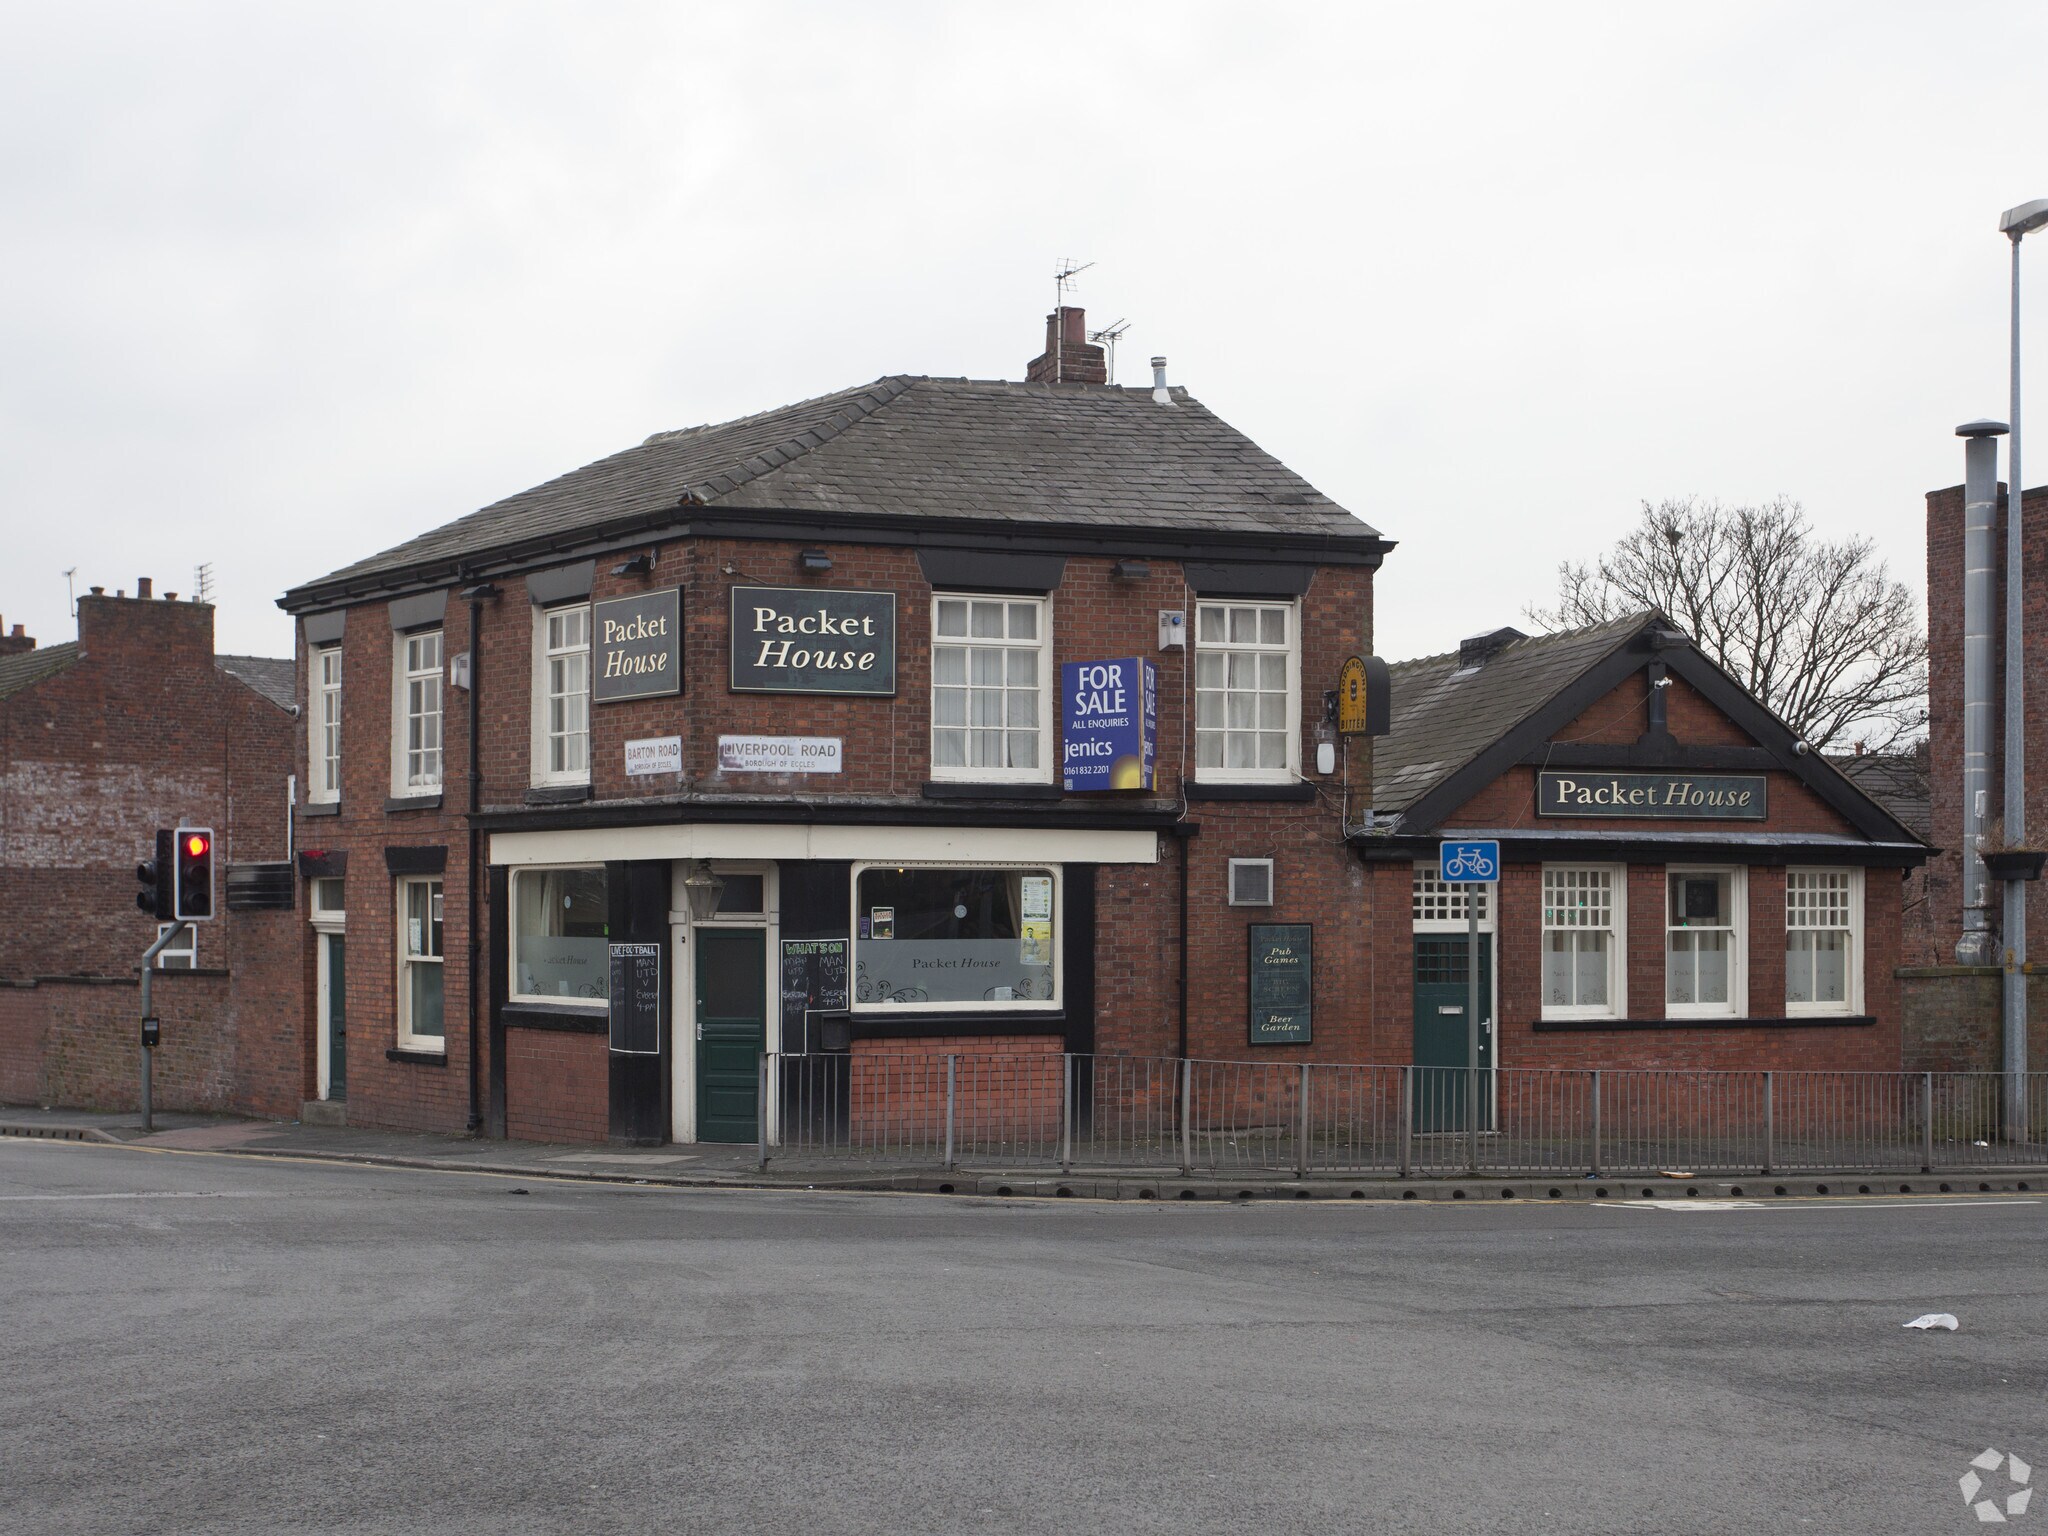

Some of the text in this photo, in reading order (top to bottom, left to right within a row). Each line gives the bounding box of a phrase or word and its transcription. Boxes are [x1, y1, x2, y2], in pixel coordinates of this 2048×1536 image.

[753, 607, 875, 636] Packet
[603, 614, 667, 644] Packet
[753, 640, 875, 670] House
[603, 649, 667, 678] House
[1079, 665, 1123, 690] FOR
[1342, 661, 1365, 693] BODDINGTONS
[1075, 690, 1127, 715] SALE
[1072, 717, 1129, 729] ALL ENQUIRIES
[1341, 719, 1364, 729] BITTER
[627, 743, 678, 760] BARTON ROAD
[724, 743, 836, 757] LIVERPOOL ROAD
[1064, 737, 1113, 763] jenics
[744, 759, 776, 767] BOROUGH
[790, 760, 816, 768] ECCLES
[1064, 765, 1109, 775] 0161 832 2201
[1556, 780, 1751, 807] Packet House
[786, 943, 843, 955] WHAT'S ON
[1271, 947, 1292, 955] Pub
[636, 958, 655, 967] MAN
[819, 955, 843, 967] MAN
[912, 958, 1001, 968] Packet House
[1264, 956, 1299, 964] Games
[636, 968, 658, 978] UTD
[825, 966, 847, 976] UTD
[1270, 1015, 1292, 1023] Beer
[1261, 1024, 1300, 1032] Garden
